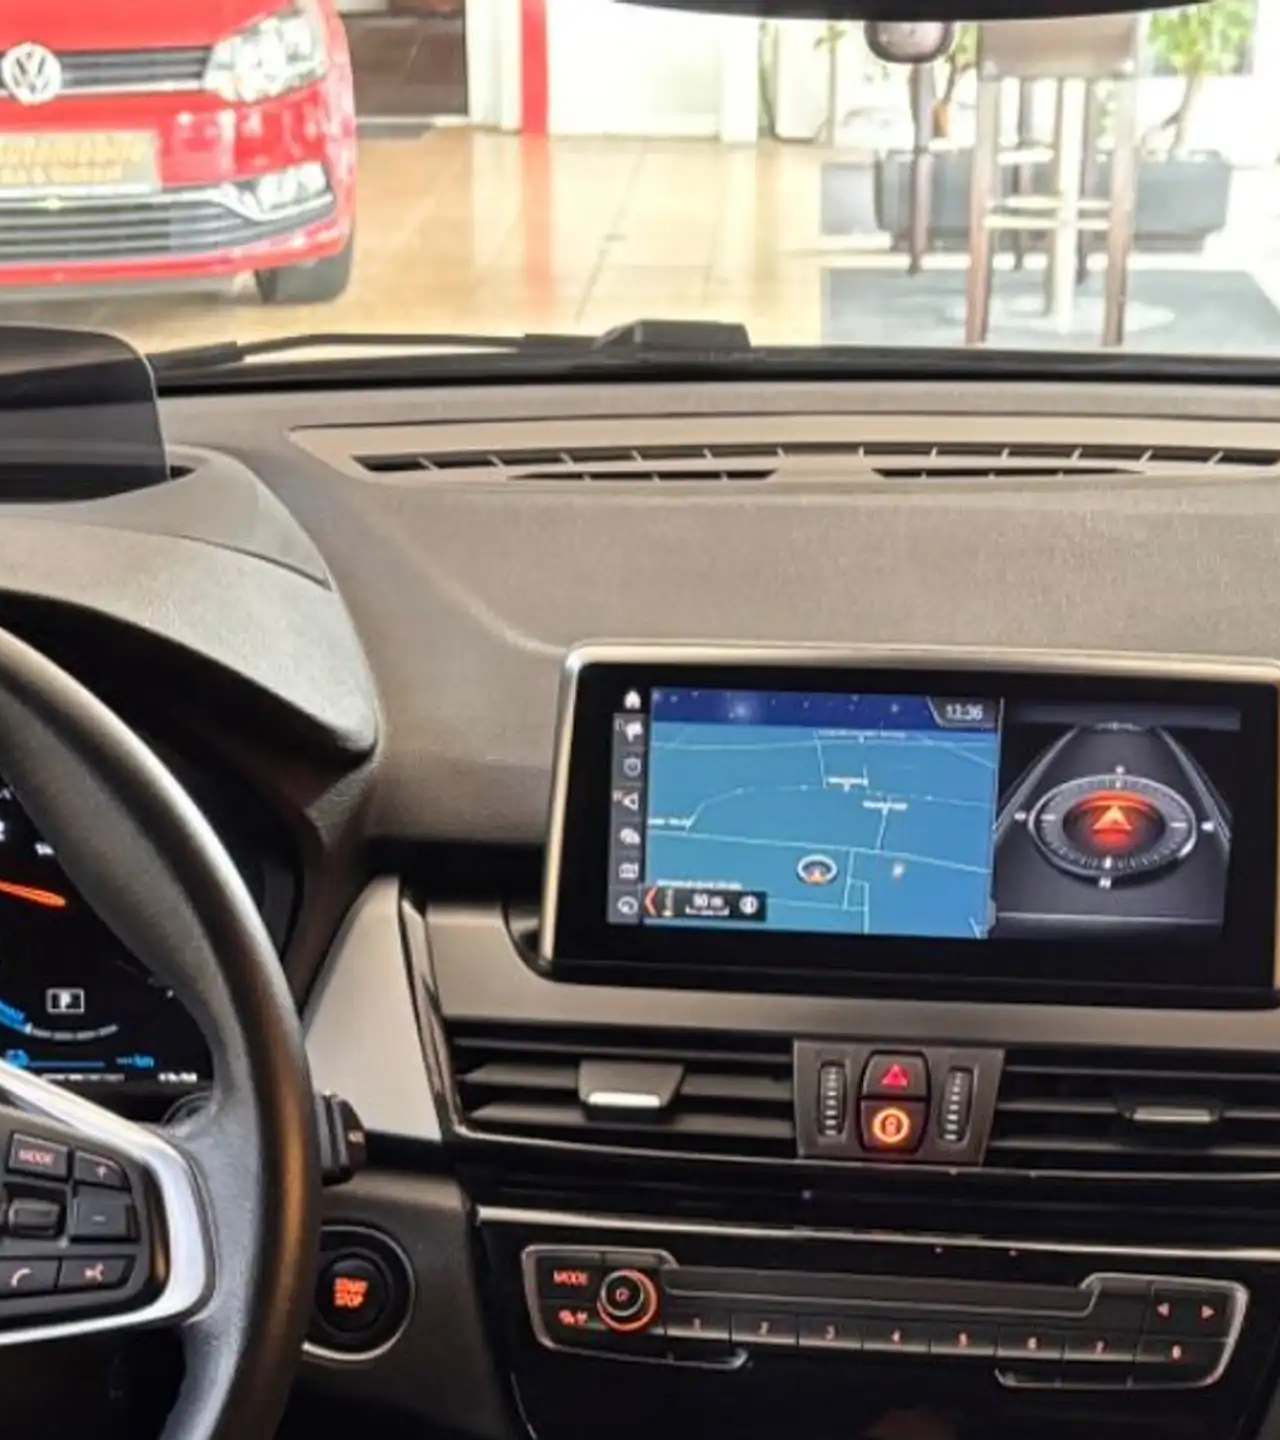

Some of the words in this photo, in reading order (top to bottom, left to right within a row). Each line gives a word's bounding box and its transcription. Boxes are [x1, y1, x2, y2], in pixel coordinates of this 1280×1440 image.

[553, 1270, 589, 1286] MODE
[826, 1326, 836, 1342] 3
[891, 1329, 902, 1345] 4
